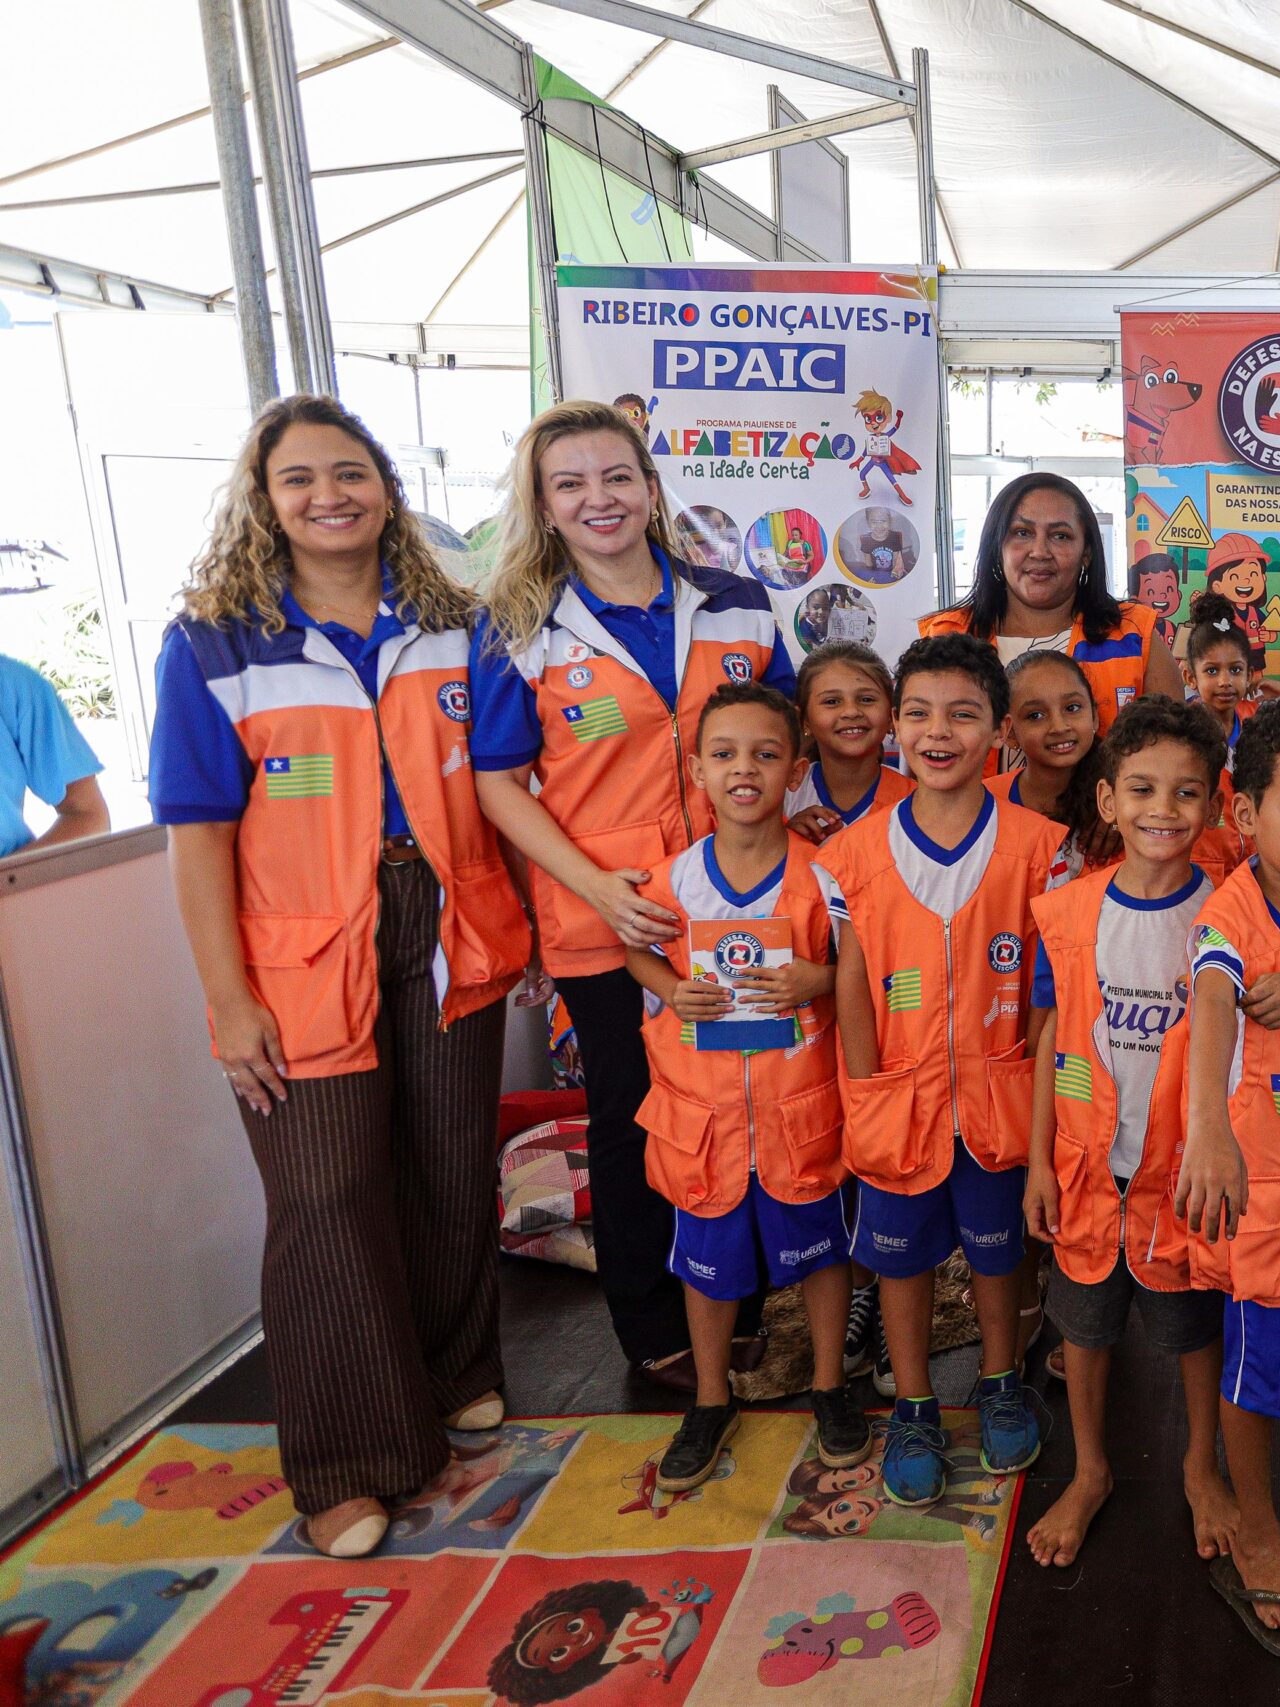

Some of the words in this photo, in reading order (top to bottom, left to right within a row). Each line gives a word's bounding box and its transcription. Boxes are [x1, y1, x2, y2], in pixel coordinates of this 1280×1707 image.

[583, 300, 700, 327] RIBEIRO
[710, 303, 931, 337] GONÇALVES-PI
[665, 346, 837, 389] PPAIC
[696, 419, 741, 428] PROGRAMA
[743, 420, 784, 429] PIAUIENSE
[786, 421, 797, 429] DE
[650, 421, 856, 466] ALFABETIZAÇÃO
[1233, 426, 1258, 457] NA
[683, 463, 705, 477] na
[710, 459, 754, 478] Idade
[760, 461, 809, 480] Certa
[1225, 498, 1247, 508] DAS
[1242, 512, 1249, 522] E
[1170, 526, 1202, 540] RISCO
[717, 934, 744, 953] DEFESA
[744, 936, 762, 953] CIVIL
[720, 962, 731, 974] NA
[1135, 988, 1164, 1000] MUNICIPAL
[1165, 991, 1173, 1001] DE
[1001, 1005, 1019, 1013] PIA
[1123, 1041, 1136, 1050] UM
[616, 1611, 672, 1655] 10
